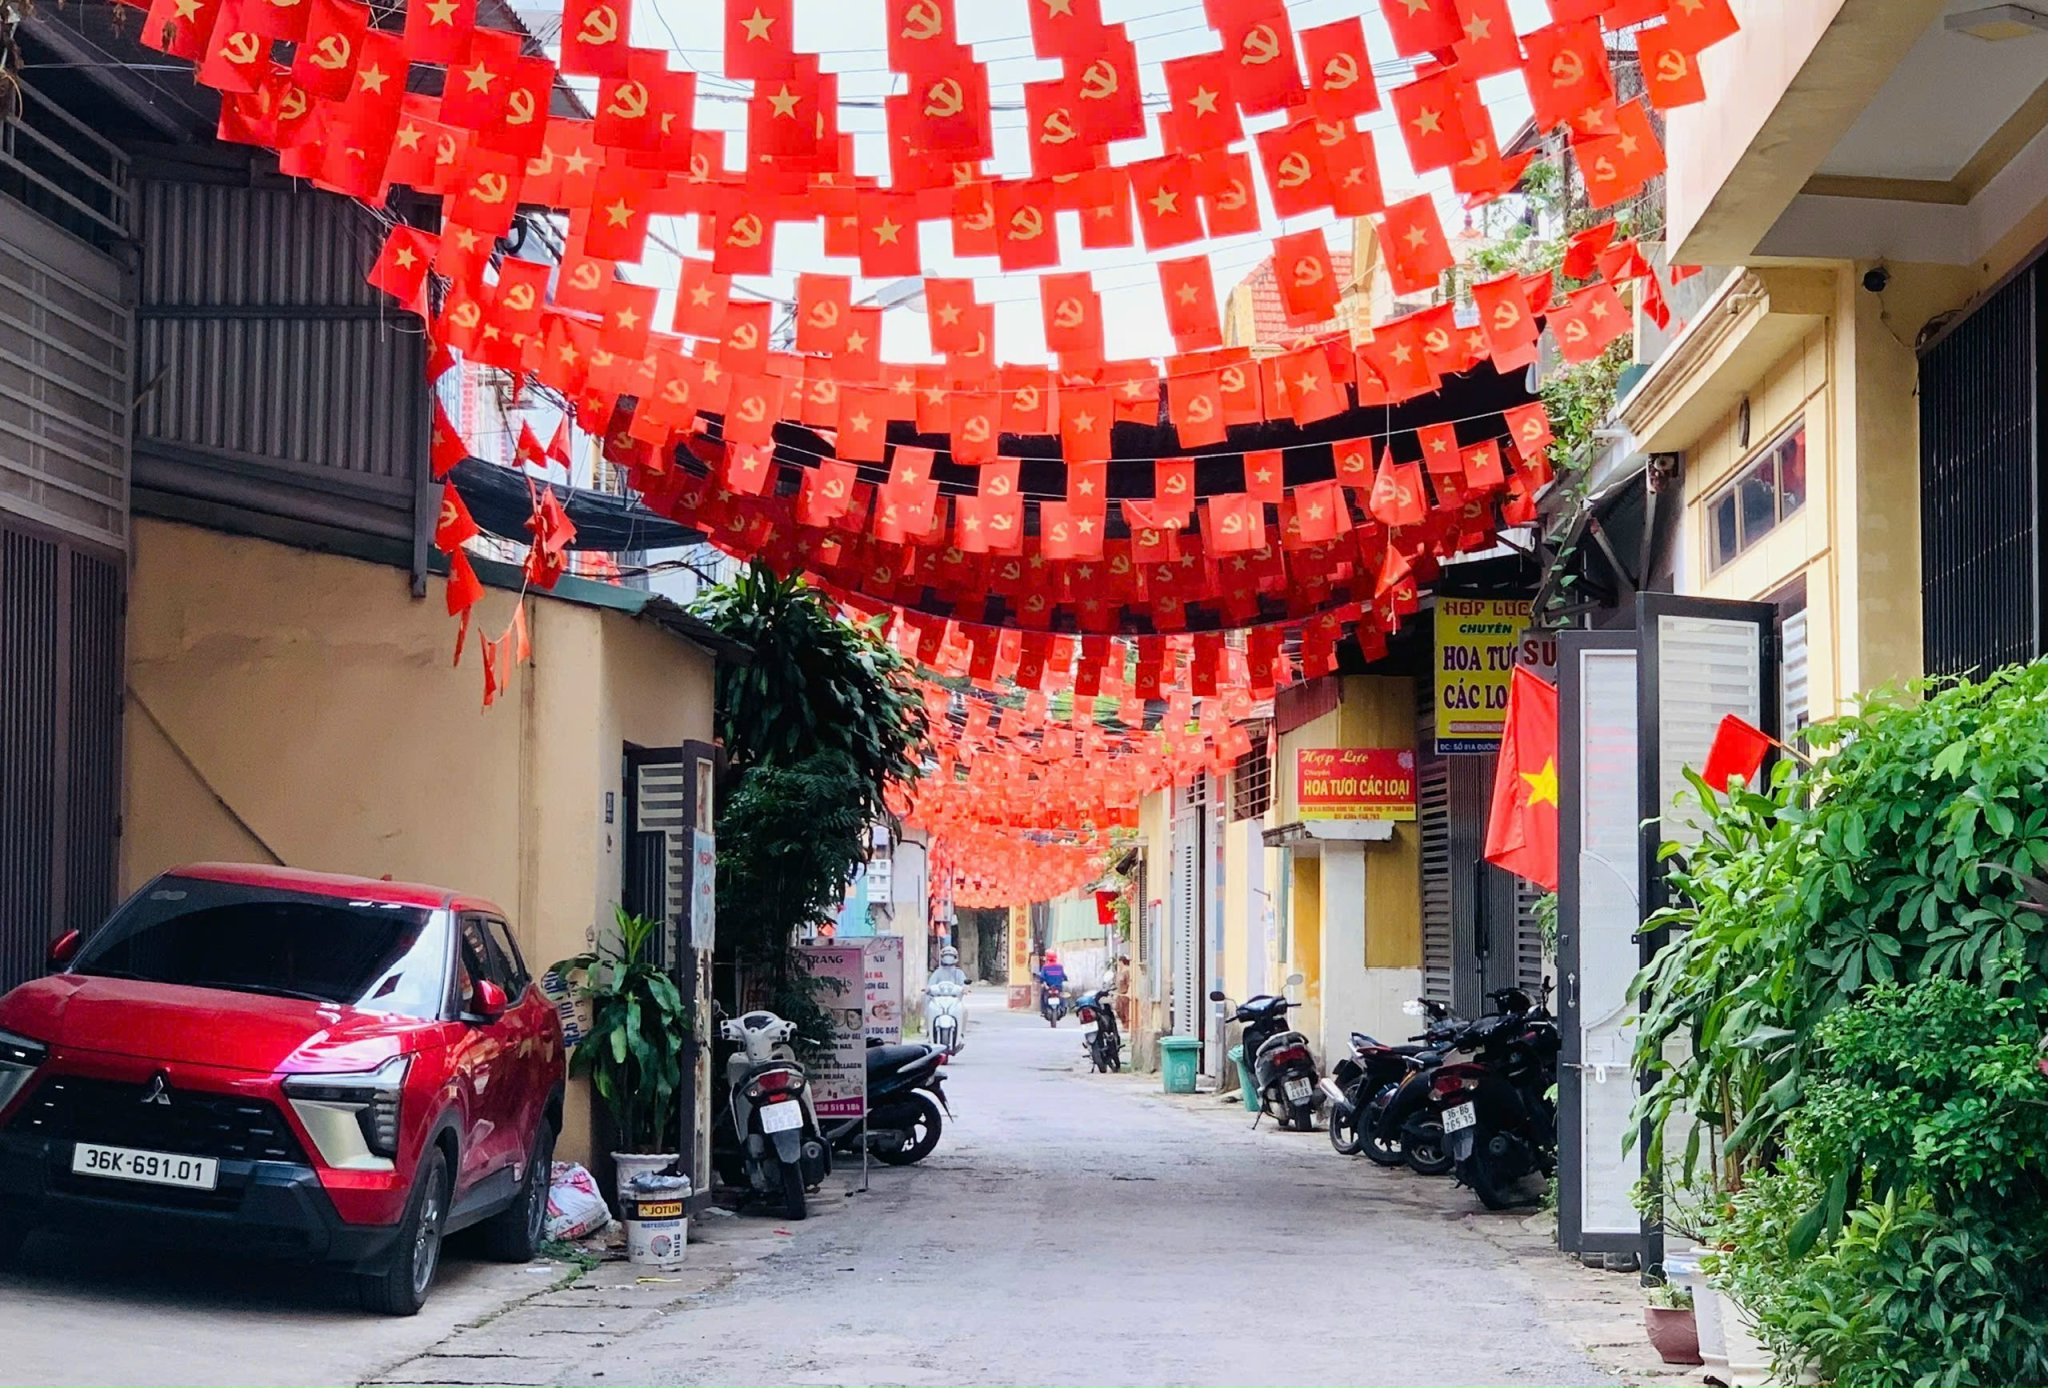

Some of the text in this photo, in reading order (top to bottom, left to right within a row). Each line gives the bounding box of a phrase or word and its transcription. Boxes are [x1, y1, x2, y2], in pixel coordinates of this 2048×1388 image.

[1459, 622, 1513, 634] CHUYÊN
[1443, 646, 1482, 671] HOA
[1443, 678, 1480, 709] CÁC
[1304, 775, 1410, 800] HOA TƯƠI CÁC LOẠI
[86, 1149, 203, 1182] 36K-691.01
[650, 1205, 680, 1215] JOTUN
